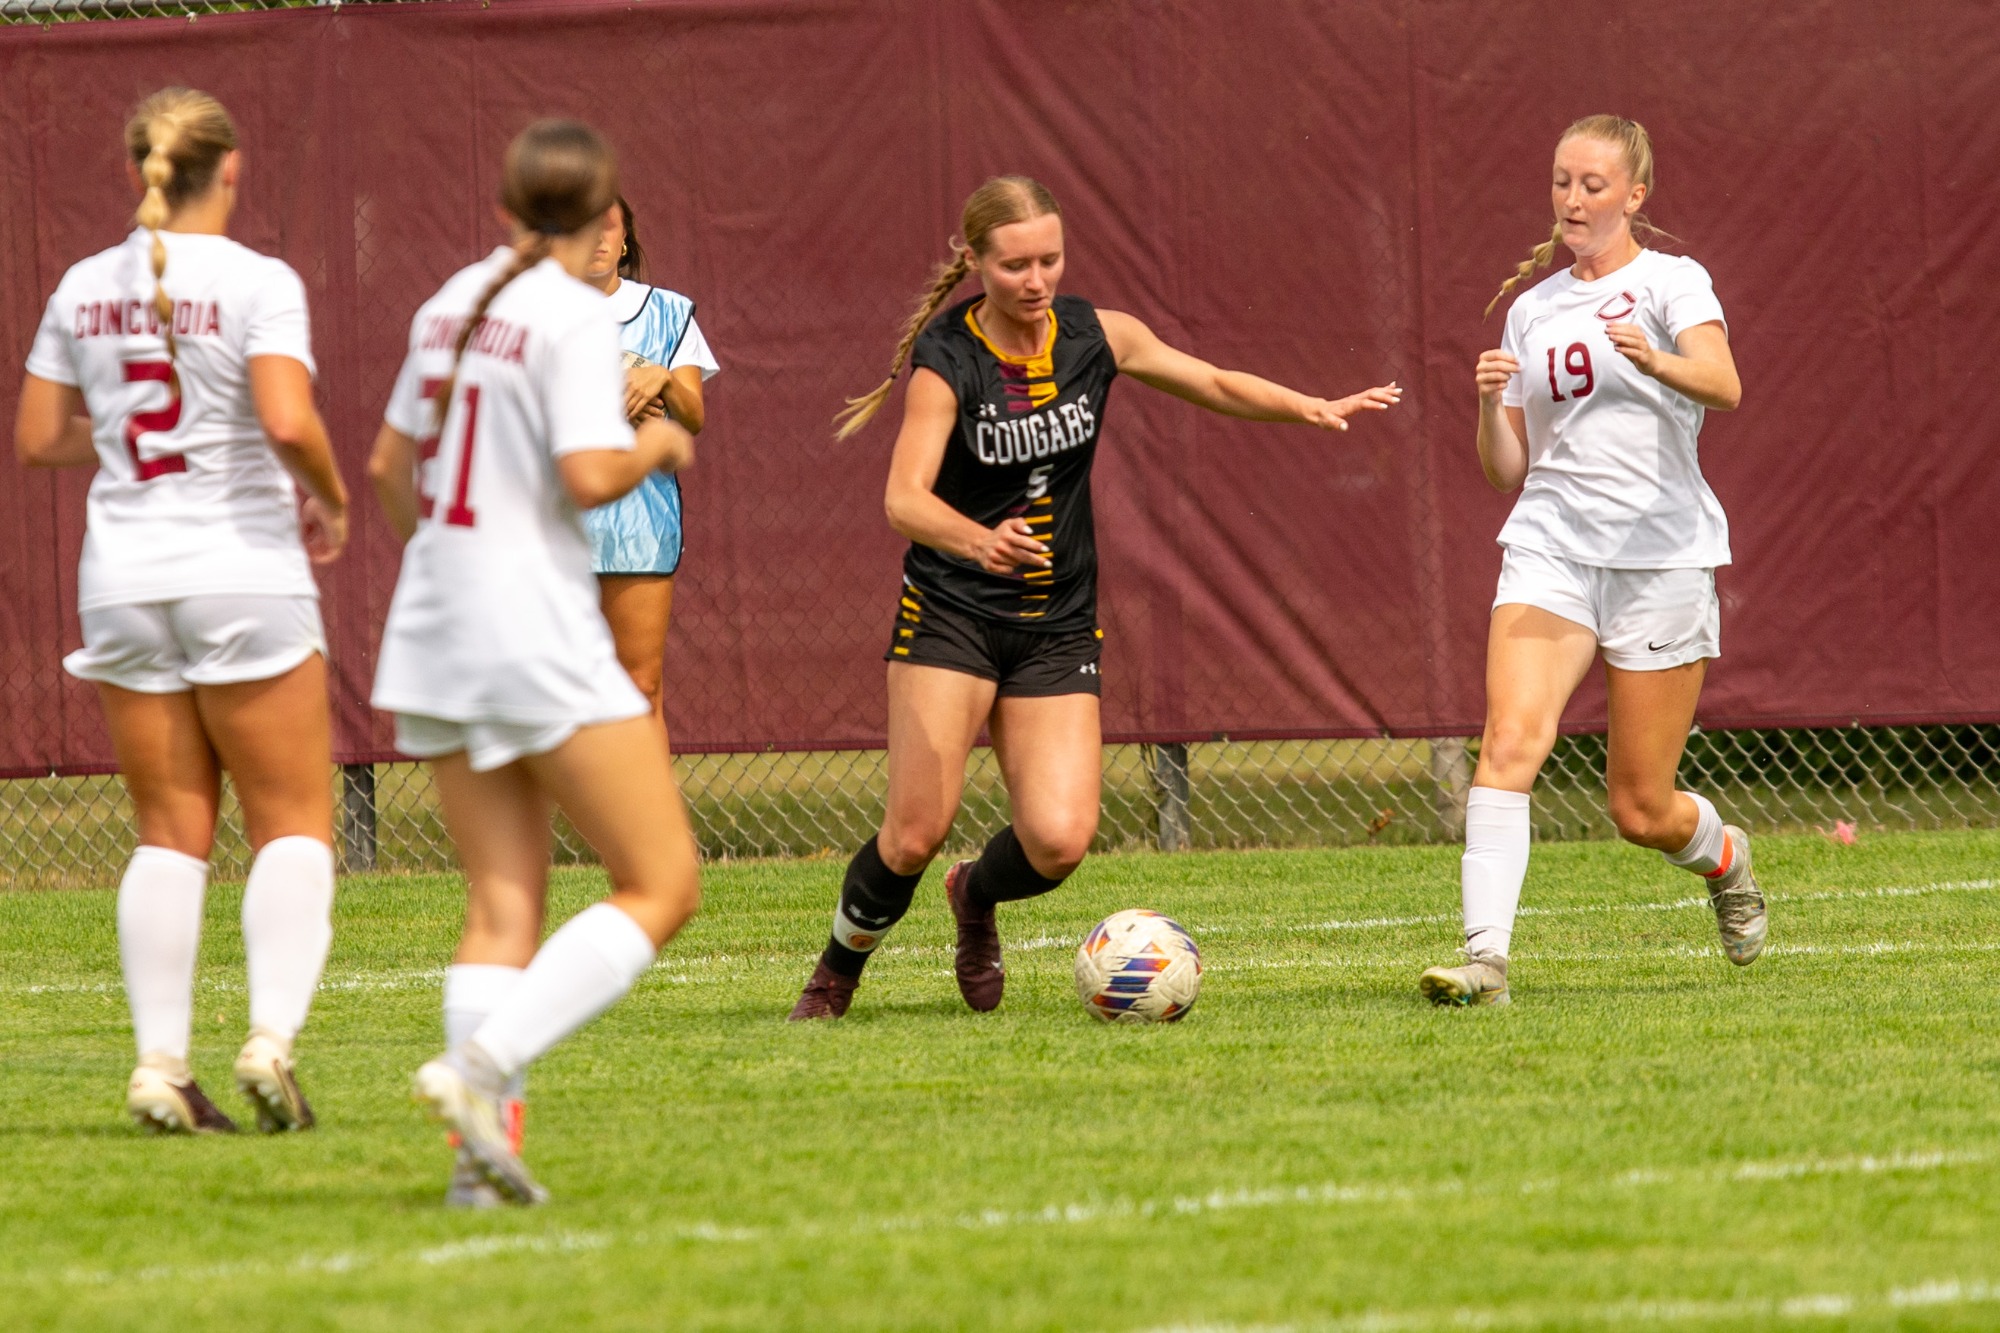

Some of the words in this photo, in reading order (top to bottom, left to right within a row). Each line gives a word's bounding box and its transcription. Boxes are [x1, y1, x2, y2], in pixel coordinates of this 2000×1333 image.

[1547, 341, 1595, 402] 19
[121, 359, 187, 482] 2
[976, 393, 1095, 465] COUGARS
[1025, 463, 1055, 499] 5
